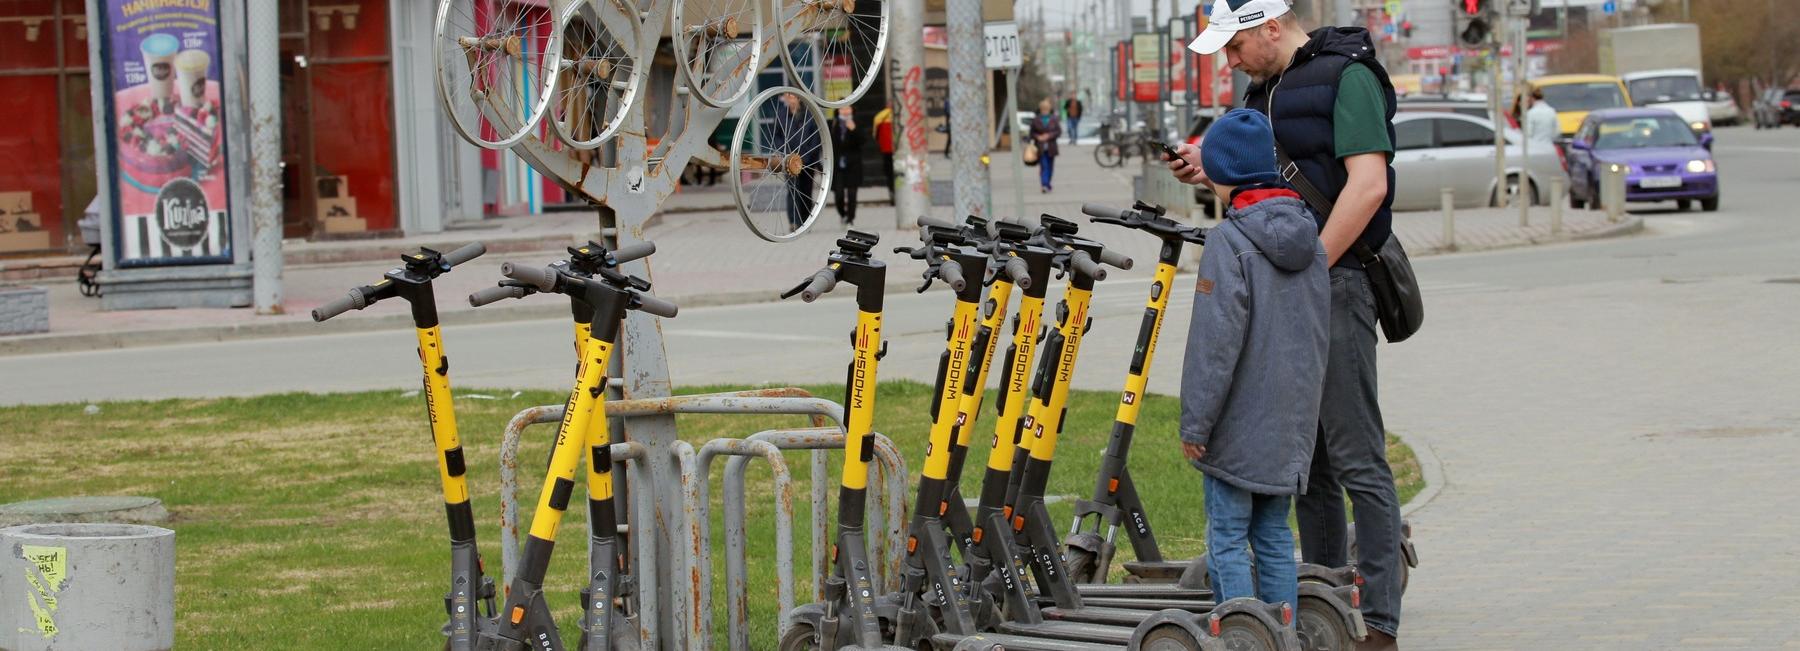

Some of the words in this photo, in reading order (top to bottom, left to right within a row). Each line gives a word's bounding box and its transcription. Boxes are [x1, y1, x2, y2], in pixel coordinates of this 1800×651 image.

[163, 197, 206, 231] Kuzina
[854, 349, 867, 409] WHOOSH
[947, 340, 966, 400] WHOOSH
[1012, 334, 1031, 393] WHOOSH
[1059, 325, 1079, 382] WHOOSH
[557, 379, 582, 446] WHOOSH
[1132, 512, 1146, 534] AC66
[1043, 554, 1055, 576] CF14
[935, 583, 947, 606] CK51
